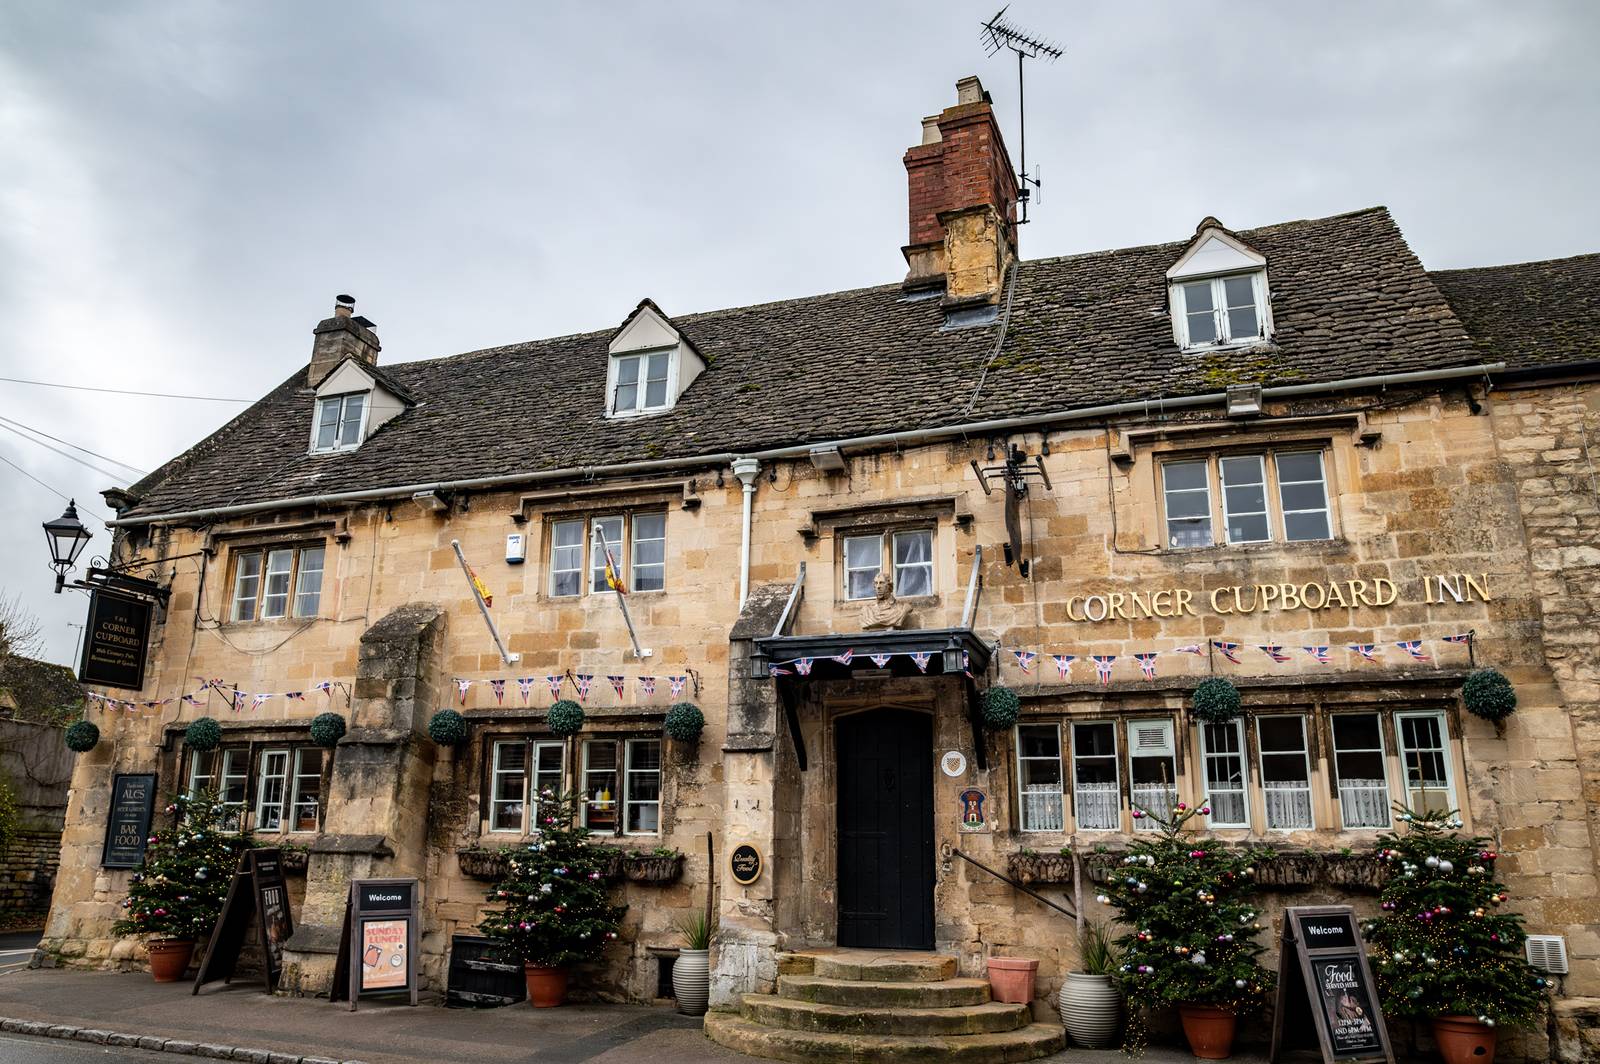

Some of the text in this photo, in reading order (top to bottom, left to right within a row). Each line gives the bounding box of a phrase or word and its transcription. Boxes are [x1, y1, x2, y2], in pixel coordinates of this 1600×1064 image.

[1066, 572, 1492, 622] CORNER CUPBOARD INN
[102, 621, 136, 636] CORNER
[95, 631, 140, 647] CUPBOARD
[122, 789, 145, 799] ALES
[120, 824, 137, 834] BAR
[114, 835, 140, 846] FOOD
[734, 853, 758, 866] Quality
[736, 863, 755, 872] Food
[368, 894, 402, 902] Welcome
[366, 927, 405, 936] SUNDAY
[1307, 925, 1344, 935] Welcome
[369, 935, 401, 944] LUNCH
[1324, 964, 1354, 984] Food
[1325, 982, 1345, 990] SERVED
[1335, 1027, 1348, 1035] AND
